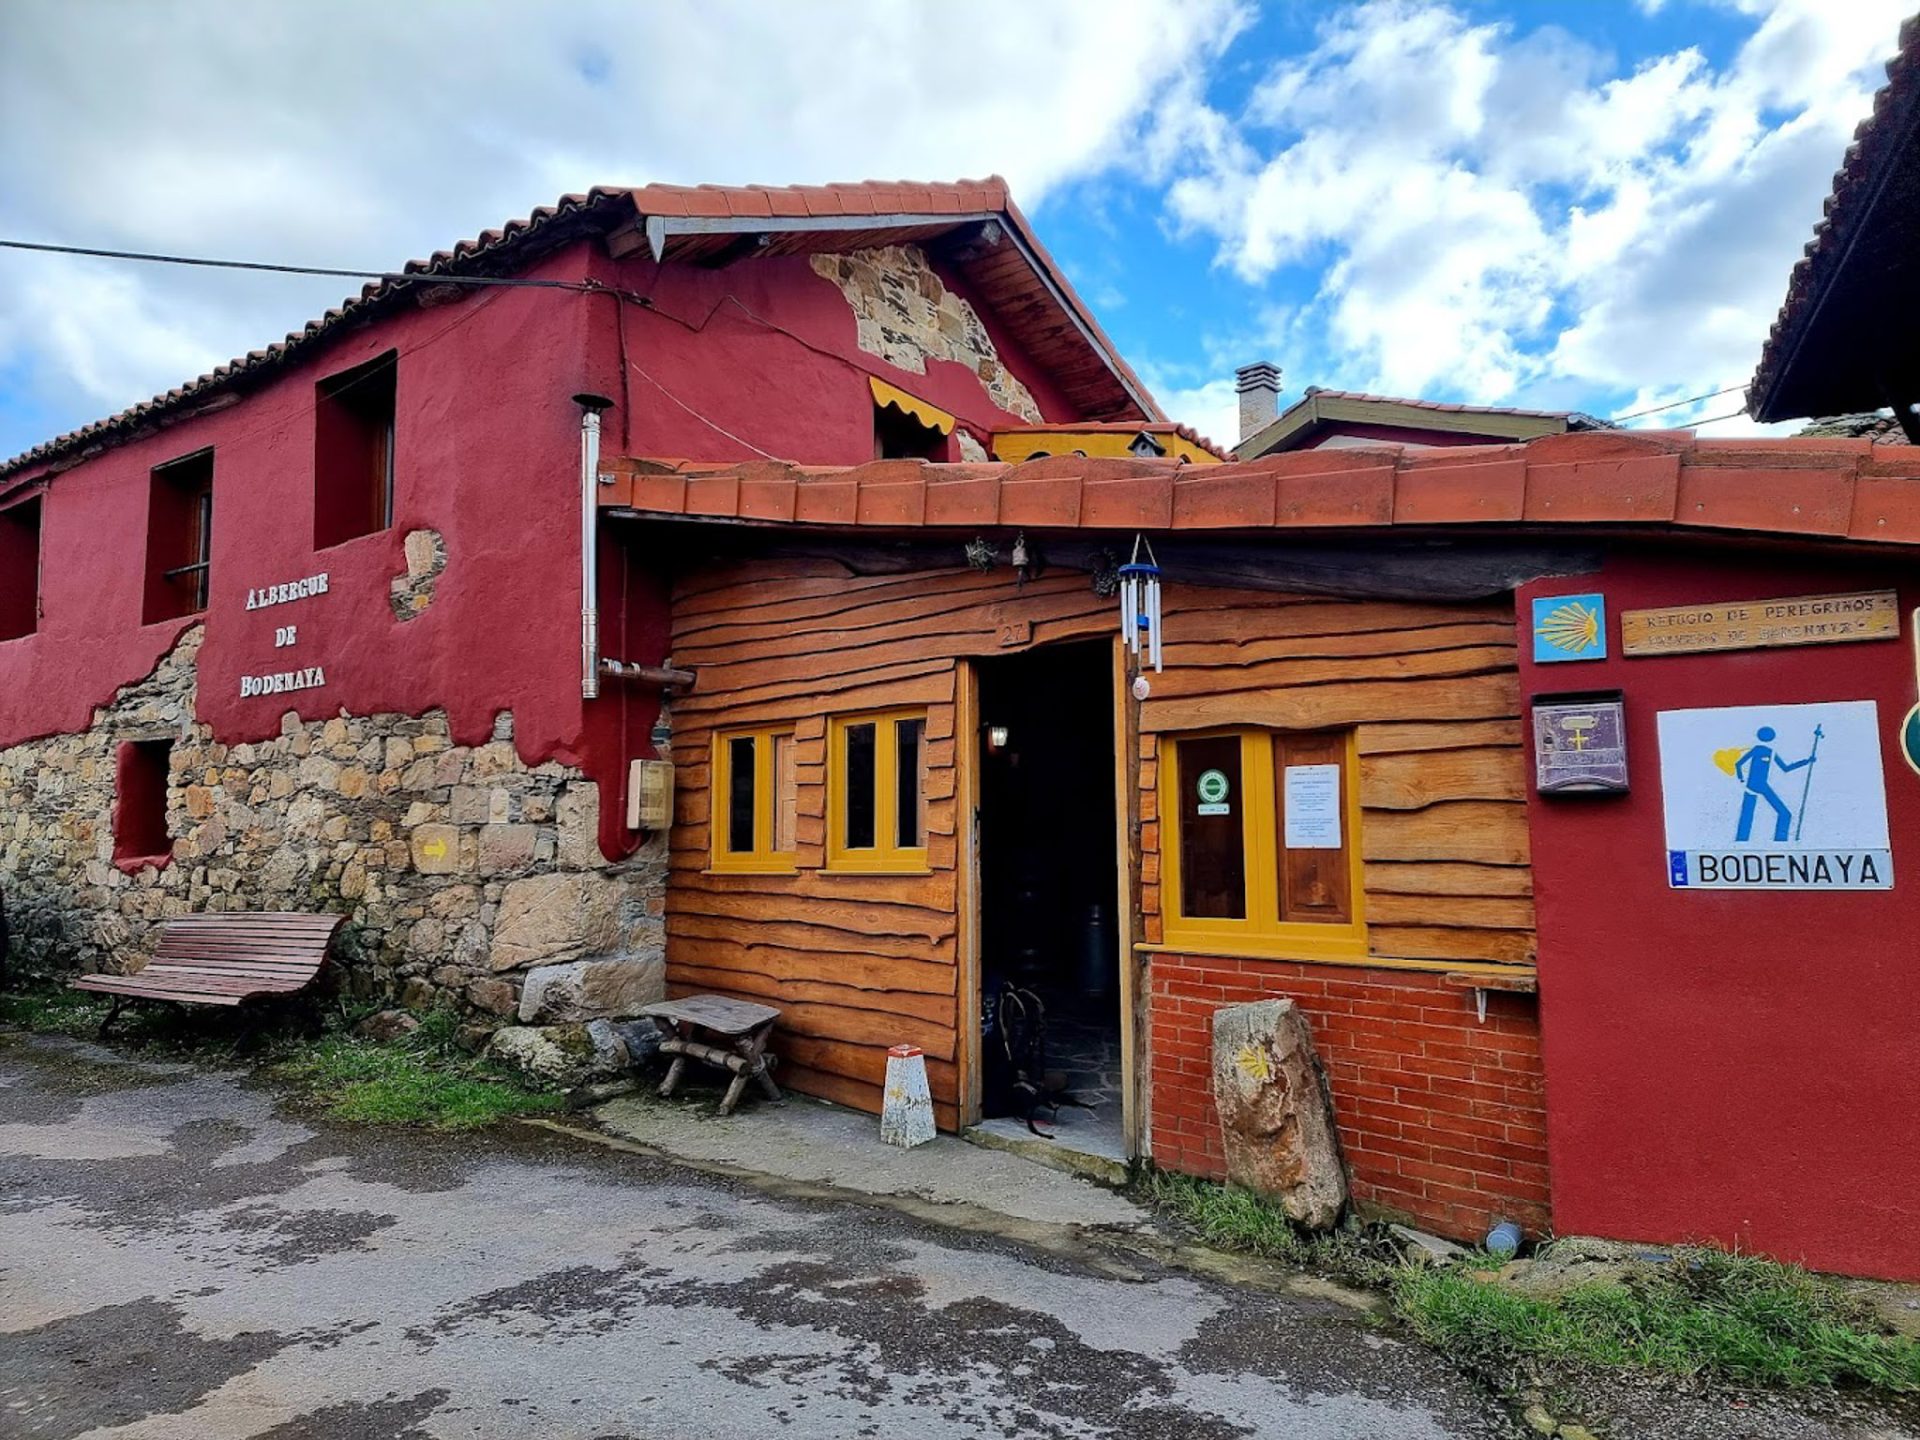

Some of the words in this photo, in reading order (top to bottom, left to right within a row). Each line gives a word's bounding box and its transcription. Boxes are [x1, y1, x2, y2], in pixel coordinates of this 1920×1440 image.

[245, 573, 329, 611] ALBERGUE
[1727, 609, 1749, 621] DE
[1765, 598, 1874, 618] PEREGRINOS
[275, 625, 298, 648] DE
[1002, 623, 1024, 642] 27
[240, 666, 326, 698] BODENAYA
[1699, 854, 1880, 884] BODENAYA
